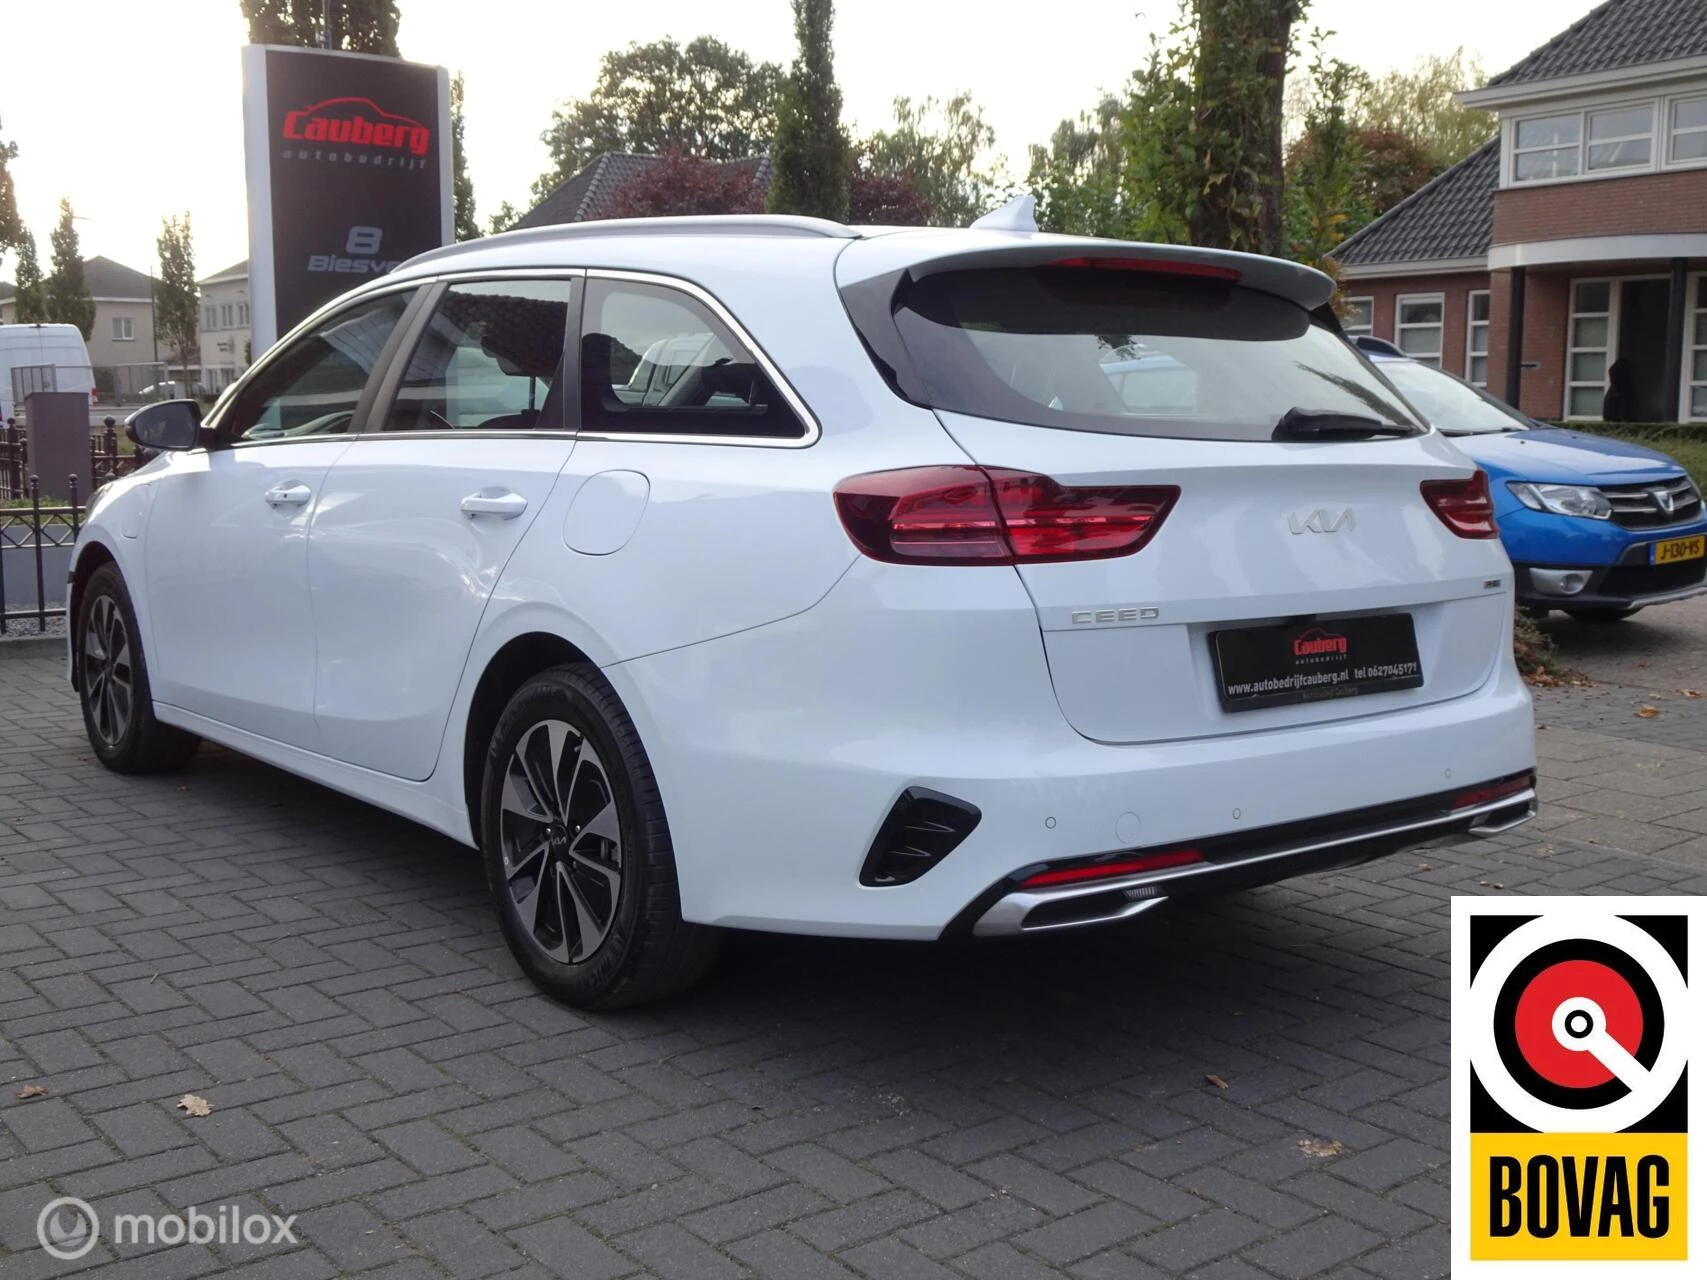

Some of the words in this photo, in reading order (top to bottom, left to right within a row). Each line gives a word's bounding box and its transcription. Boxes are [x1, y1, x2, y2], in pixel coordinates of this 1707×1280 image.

[283, 110, 430, 155] Cauberg
[282, 149, 427, 170] autobedrijf
[1072, 606, 1159, 625] CEED
[1294, 637, 1347, 655] Cauberg
[1228, 669, 1349, 695] www.autobedrijfcauberg.nl
[1354, 667, 1366, 679] tel
[1367, 662, 1417, 677] 0627045171
